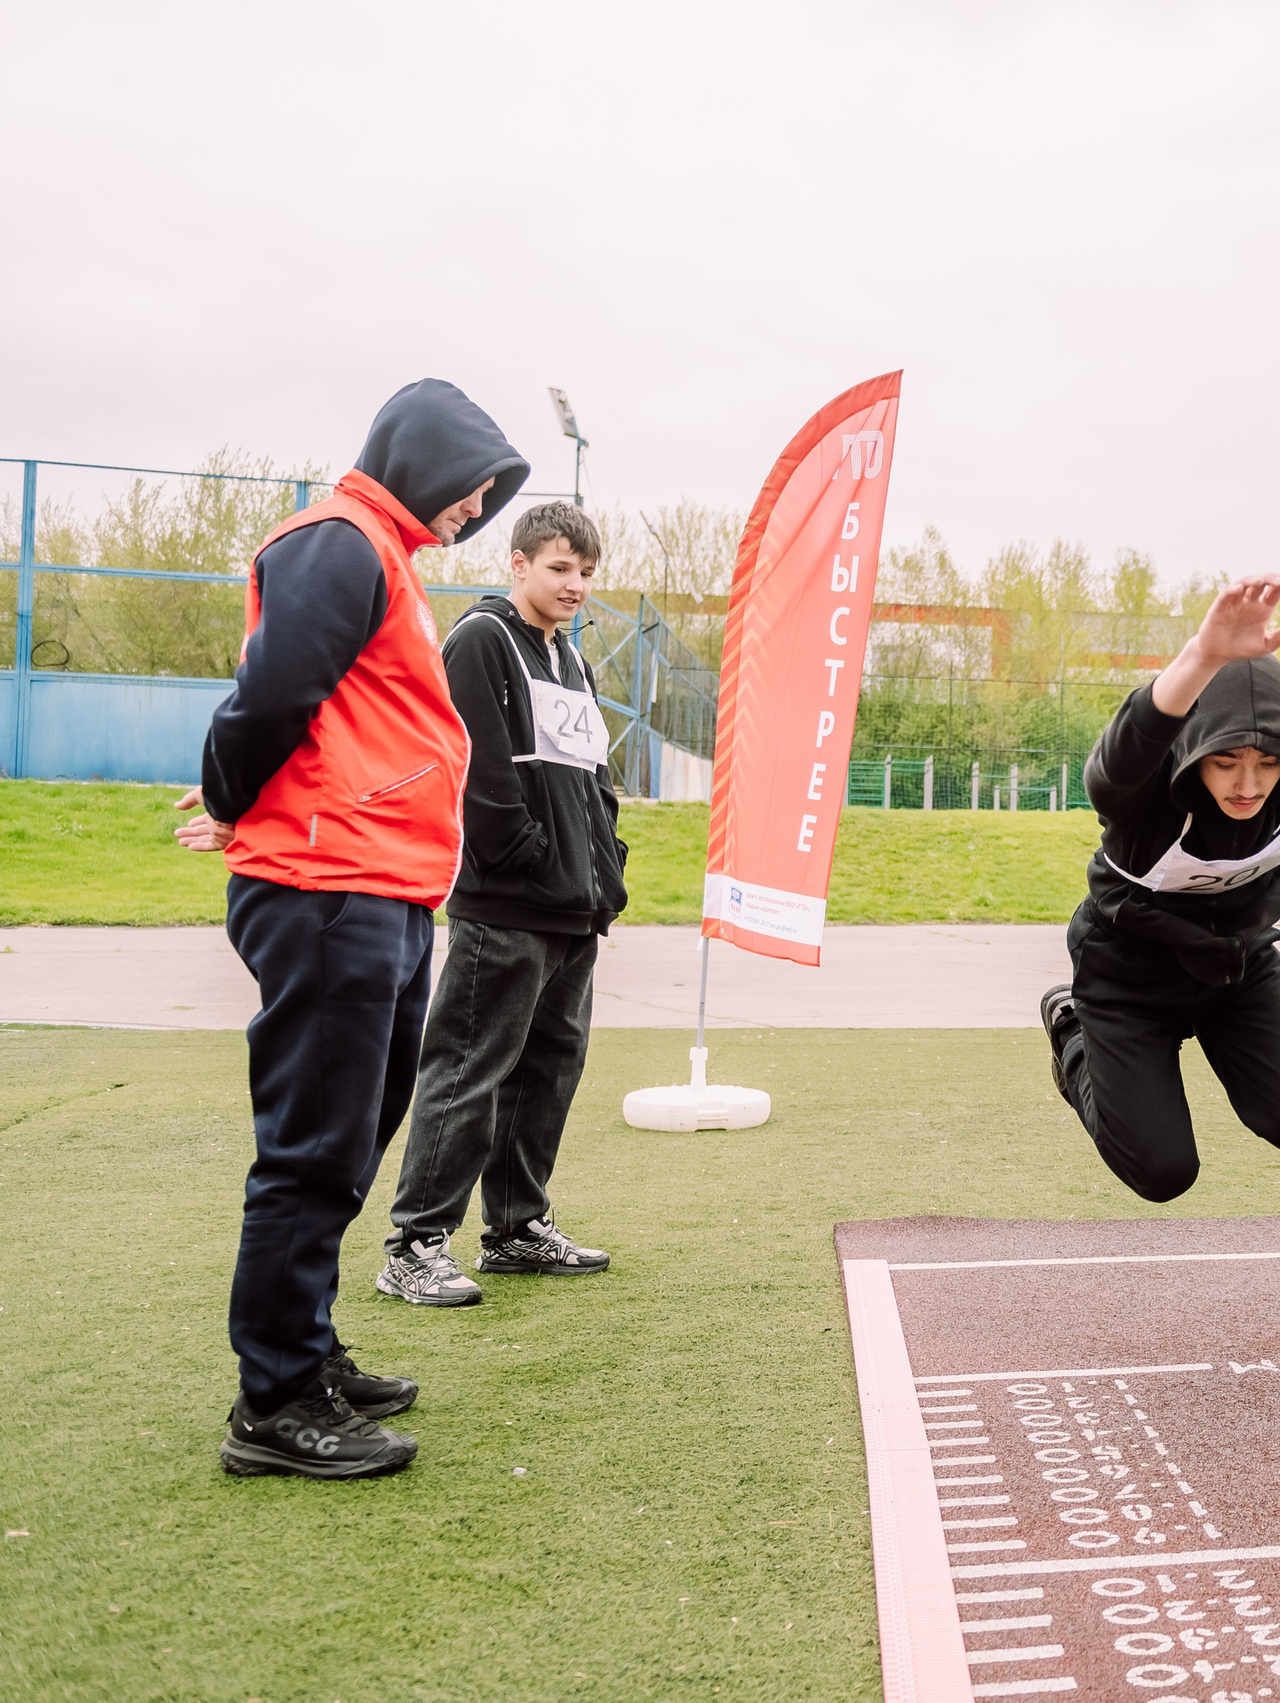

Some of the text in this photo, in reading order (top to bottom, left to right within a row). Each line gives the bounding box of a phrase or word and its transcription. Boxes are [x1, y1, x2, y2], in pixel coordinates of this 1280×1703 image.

[797, 501, 860, 853] БЫСТРЕЕ
[554, 699, 593, 744] 24
[1178, 865, 1261, 891] 20
[1090, 1569, 1256, 1597] 2.10
[1102, 1595, 1272, 1625] 2.20
